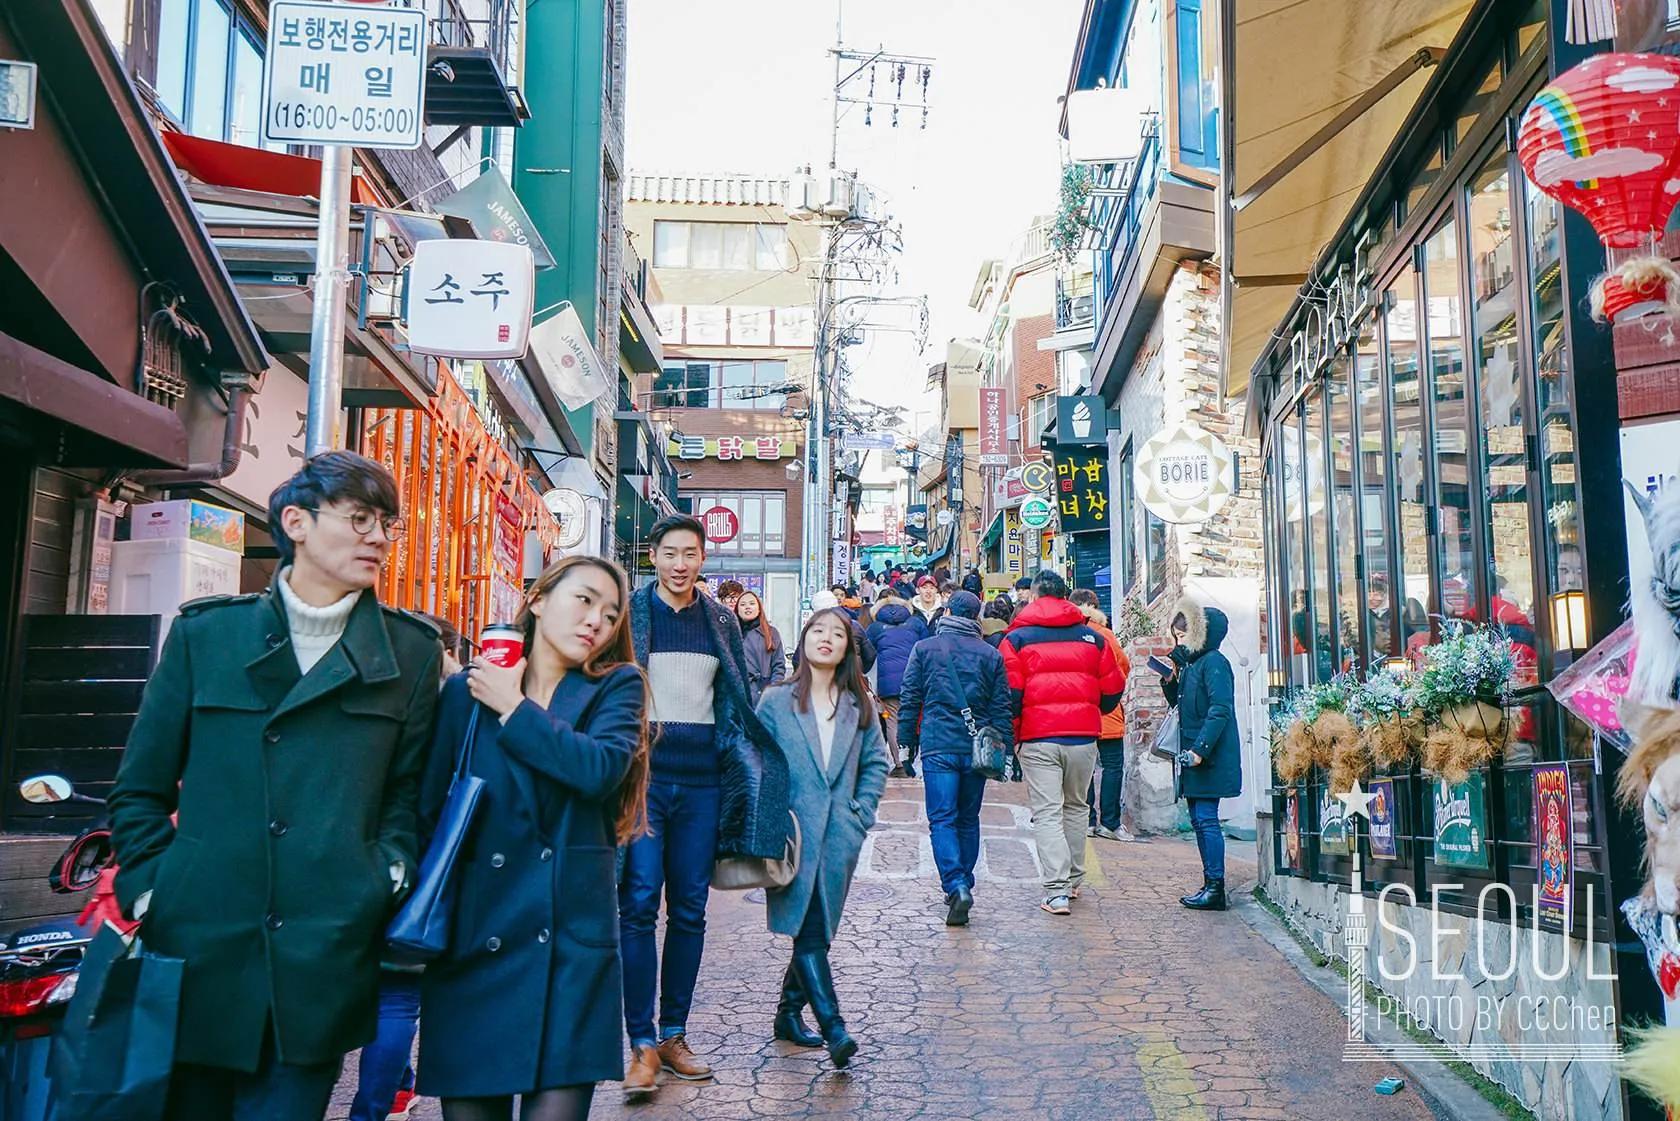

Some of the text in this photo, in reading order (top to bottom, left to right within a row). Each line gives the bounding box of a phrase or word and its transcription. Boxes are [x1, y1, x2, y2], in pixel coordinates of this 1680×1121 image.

[279, 17, 418, 56] 보행전용거리
[275, 102, 414, 134] (16:00~05:00)
[424, 271, 510, 312] 소주
[560, 335, 592, 377] JAMESON
[1160, 463, 1208, 482] BORIE
[17, 931, 73, 944] HONDA
